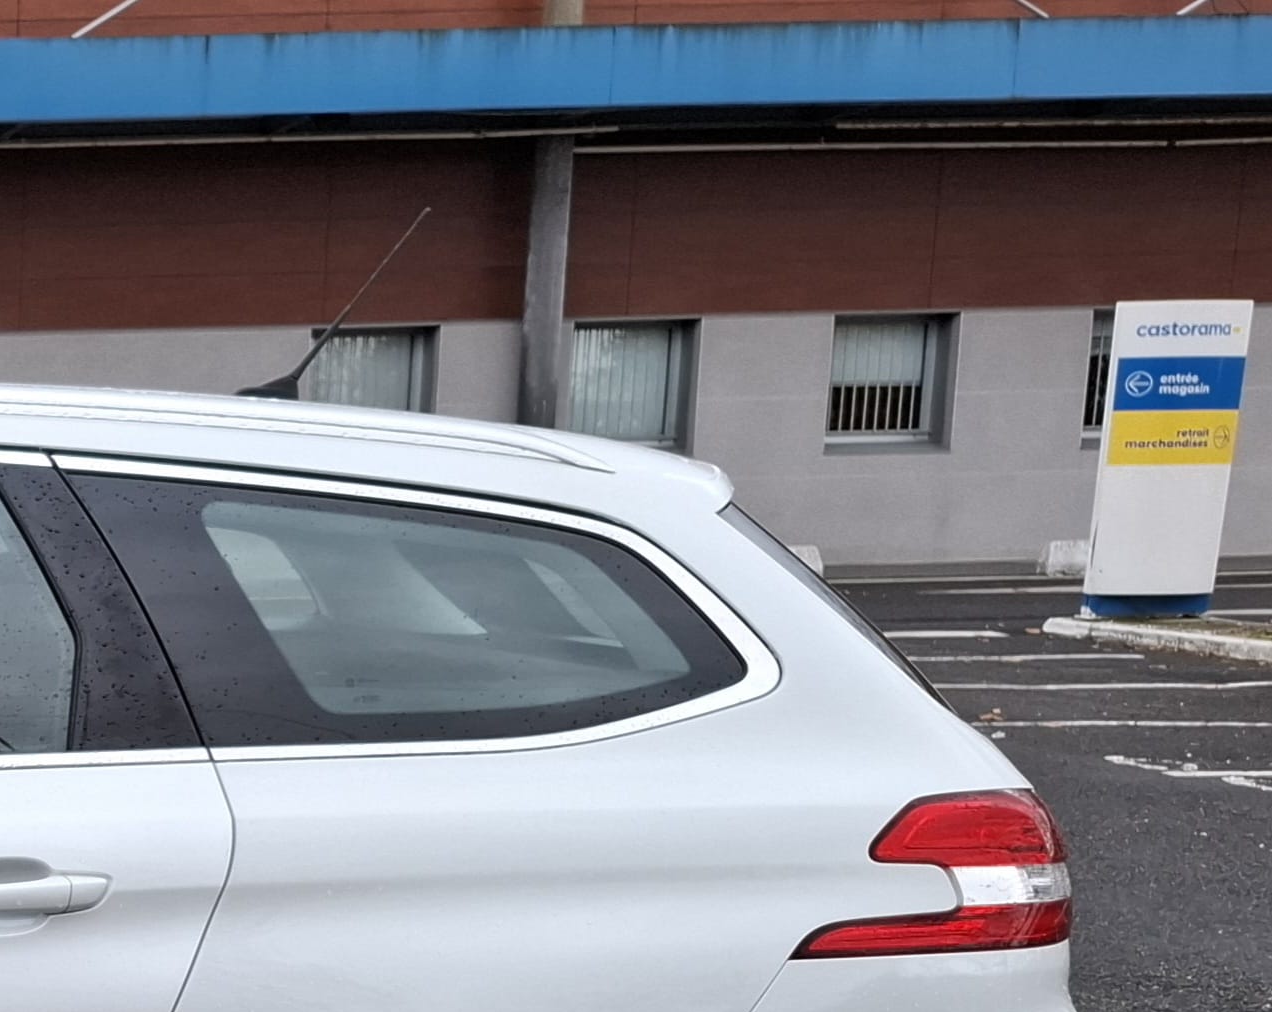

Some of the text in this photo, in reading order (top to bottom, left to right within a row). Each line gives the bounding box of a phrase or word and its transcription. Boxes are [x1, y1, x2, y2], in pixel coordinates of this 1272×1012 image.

[1136, 322, 1232, 337] castorama
[1160, 372, 1199, 384] entrée
[1158, 383, 1210, 397] magasin
[1176, 428, 1210, 438] retrait
[1124, 439, 1208, 449] marchandises
